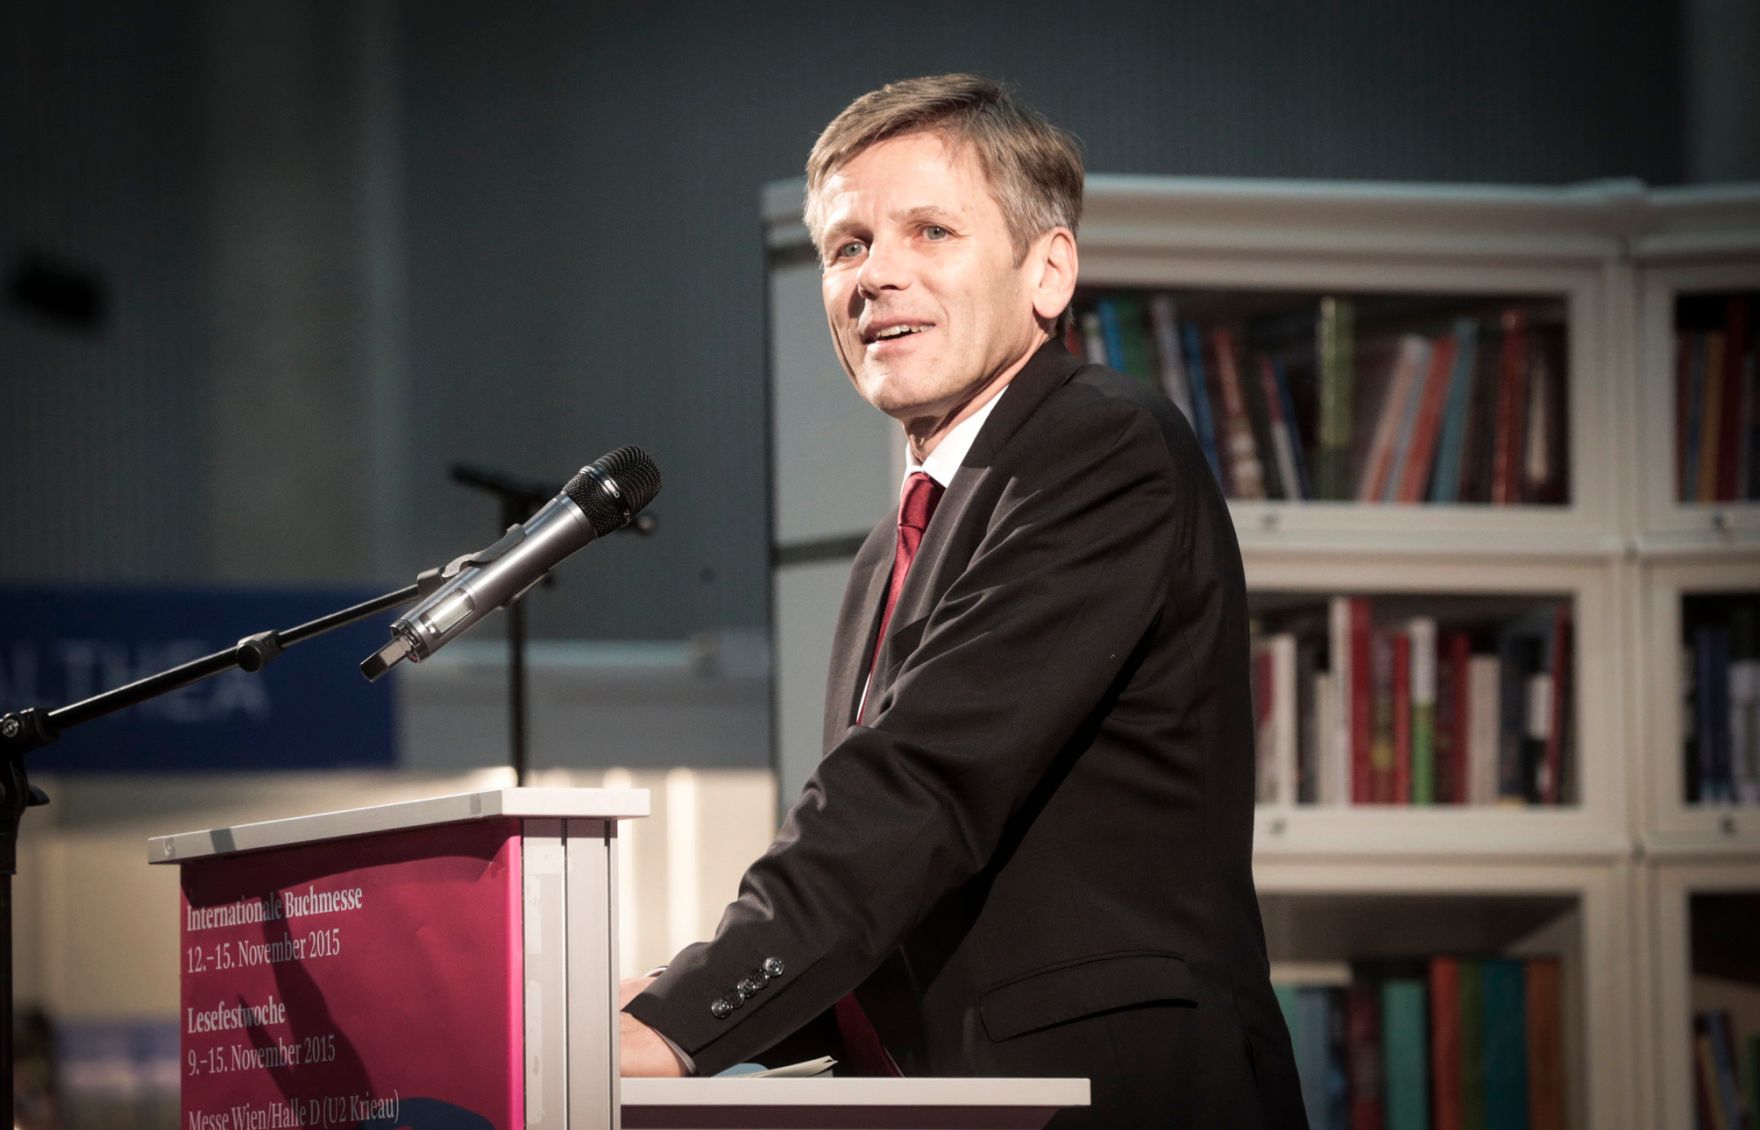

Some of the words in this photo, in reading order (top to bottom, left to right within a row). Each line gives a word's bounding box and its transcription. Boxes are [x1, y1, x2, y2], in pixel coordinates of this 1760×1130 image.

[187, 891, 282, 931] Internationale
[284, 885, 363, 918] Buchmesse
[238, 932, 306, 967] November
[309, 928, 340, 958] 2015
[187, 996, 286, 1034] Lesefestwoche
[231, 1037, 302, 1071] November
[304, 1035, 336, 1064] 2015
[188, 1108, 229, 1130] Messe
[231, 1099, 307, 1130] Wien/Halle
[309, 1099, 320, 1124] D
[323, 1096, 346, 1129] (U2
[349, 1089, 400, 1123] Krieau)
